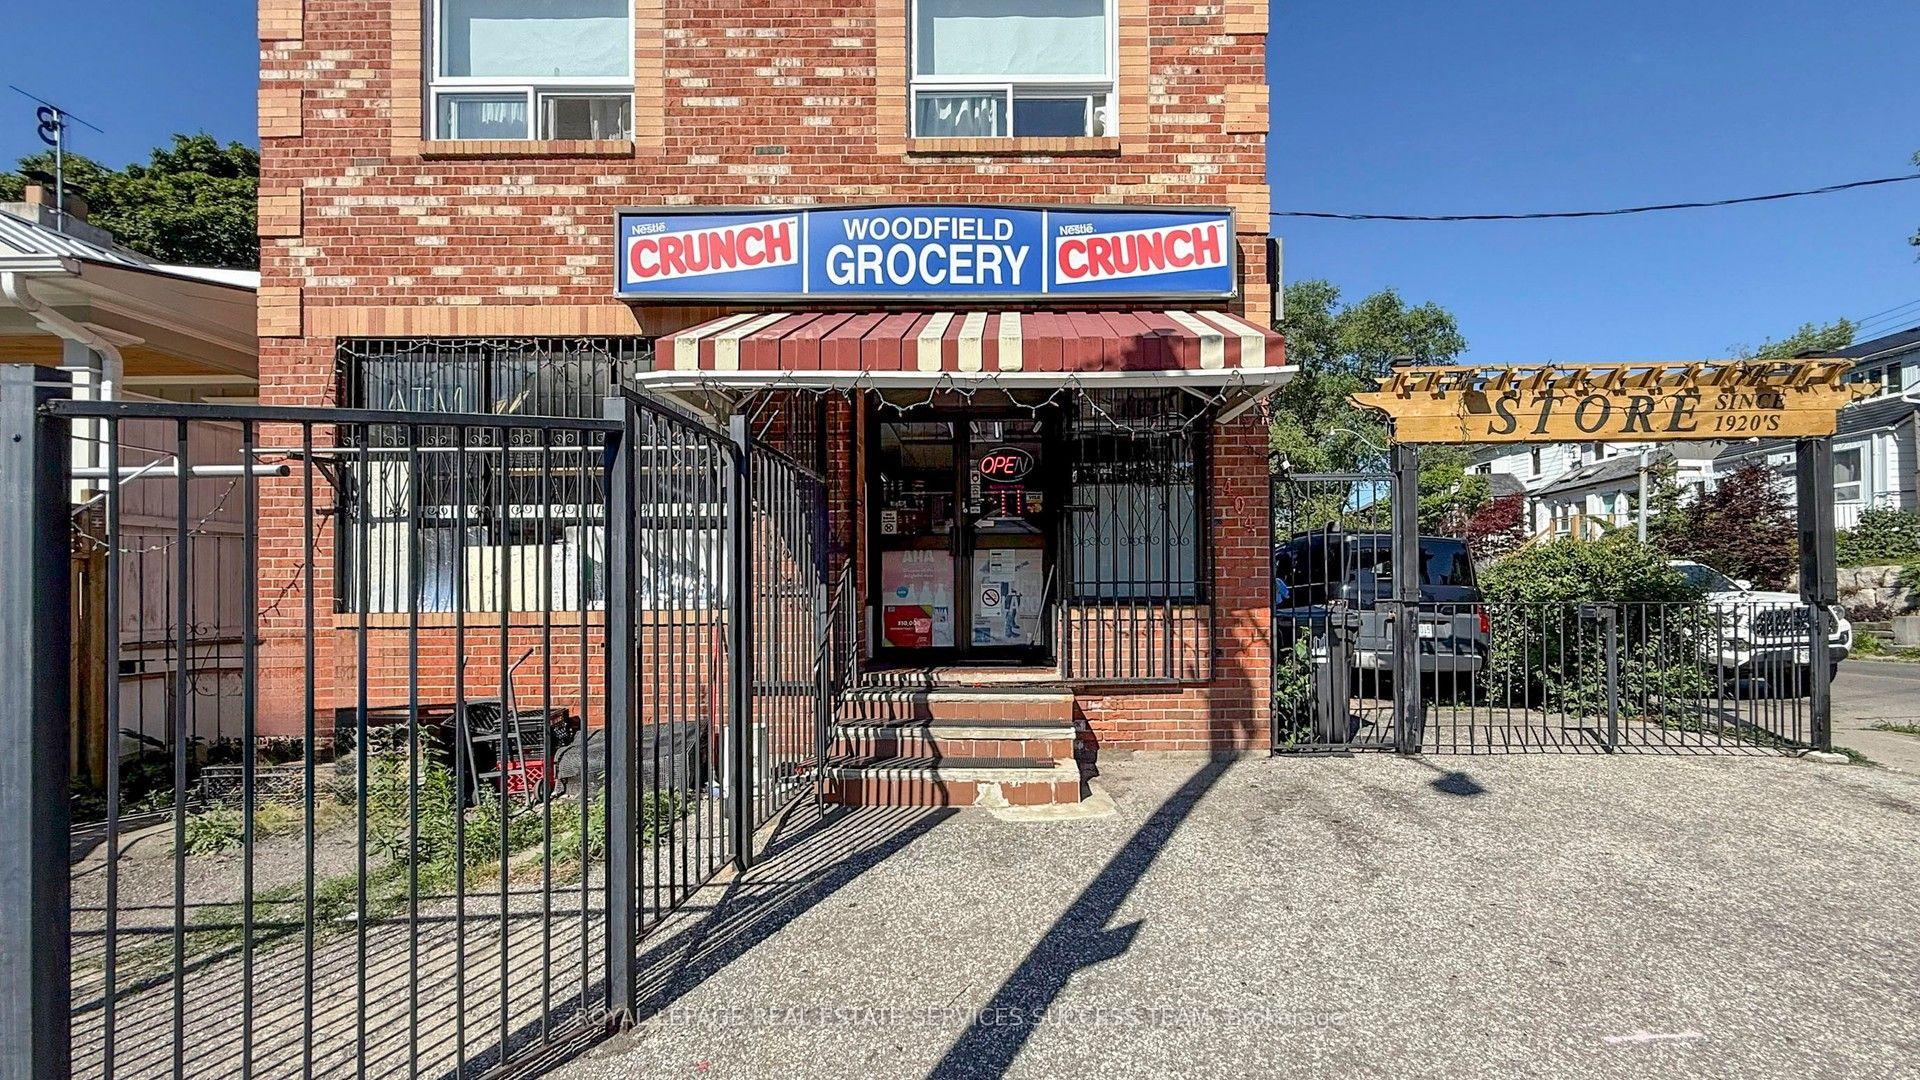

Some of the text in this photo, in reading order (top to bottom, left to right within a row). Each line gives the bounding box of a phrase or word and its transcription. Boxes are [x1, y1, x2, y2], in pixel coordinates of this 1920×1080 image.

[842, 216, 1014, 241] WOODFIELD
[630, 223, 792, 277] CRUNCH
[825, 244, 1031, 286] GROCERY
[1057, 227, 1221, 279] CRUNCH
[1488, 393, 1701, 435] STORE
[1714, 393, 1785, 411] SINCE
[1714, 414, 1780, 434] 1920'S
[980, 456, 1029, 474] OPEN
